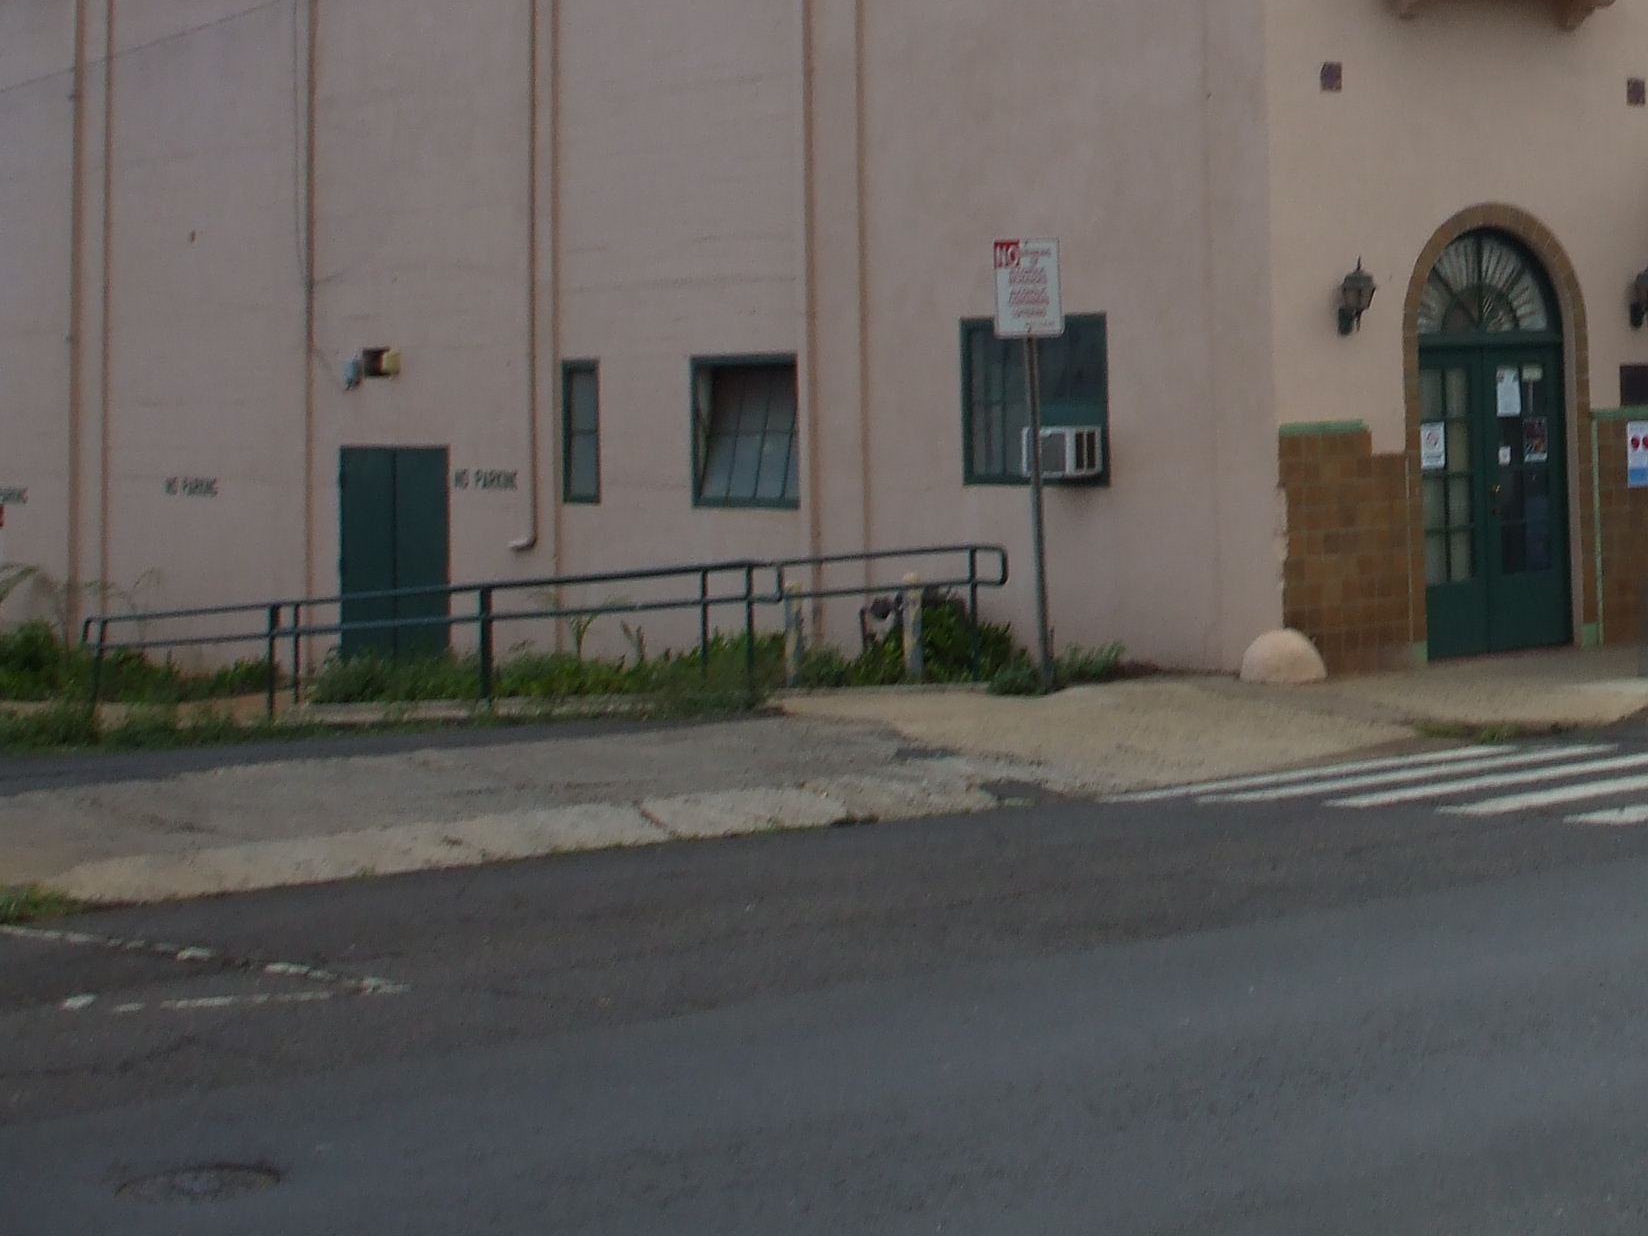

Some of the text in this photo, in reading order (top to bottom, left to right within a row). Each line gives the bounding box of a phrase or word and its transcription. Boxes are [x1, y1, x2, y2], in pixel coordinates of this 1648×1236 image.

[995, 244, 1020, 267] NO
[454, 468, 518, 491] NO PARKING
